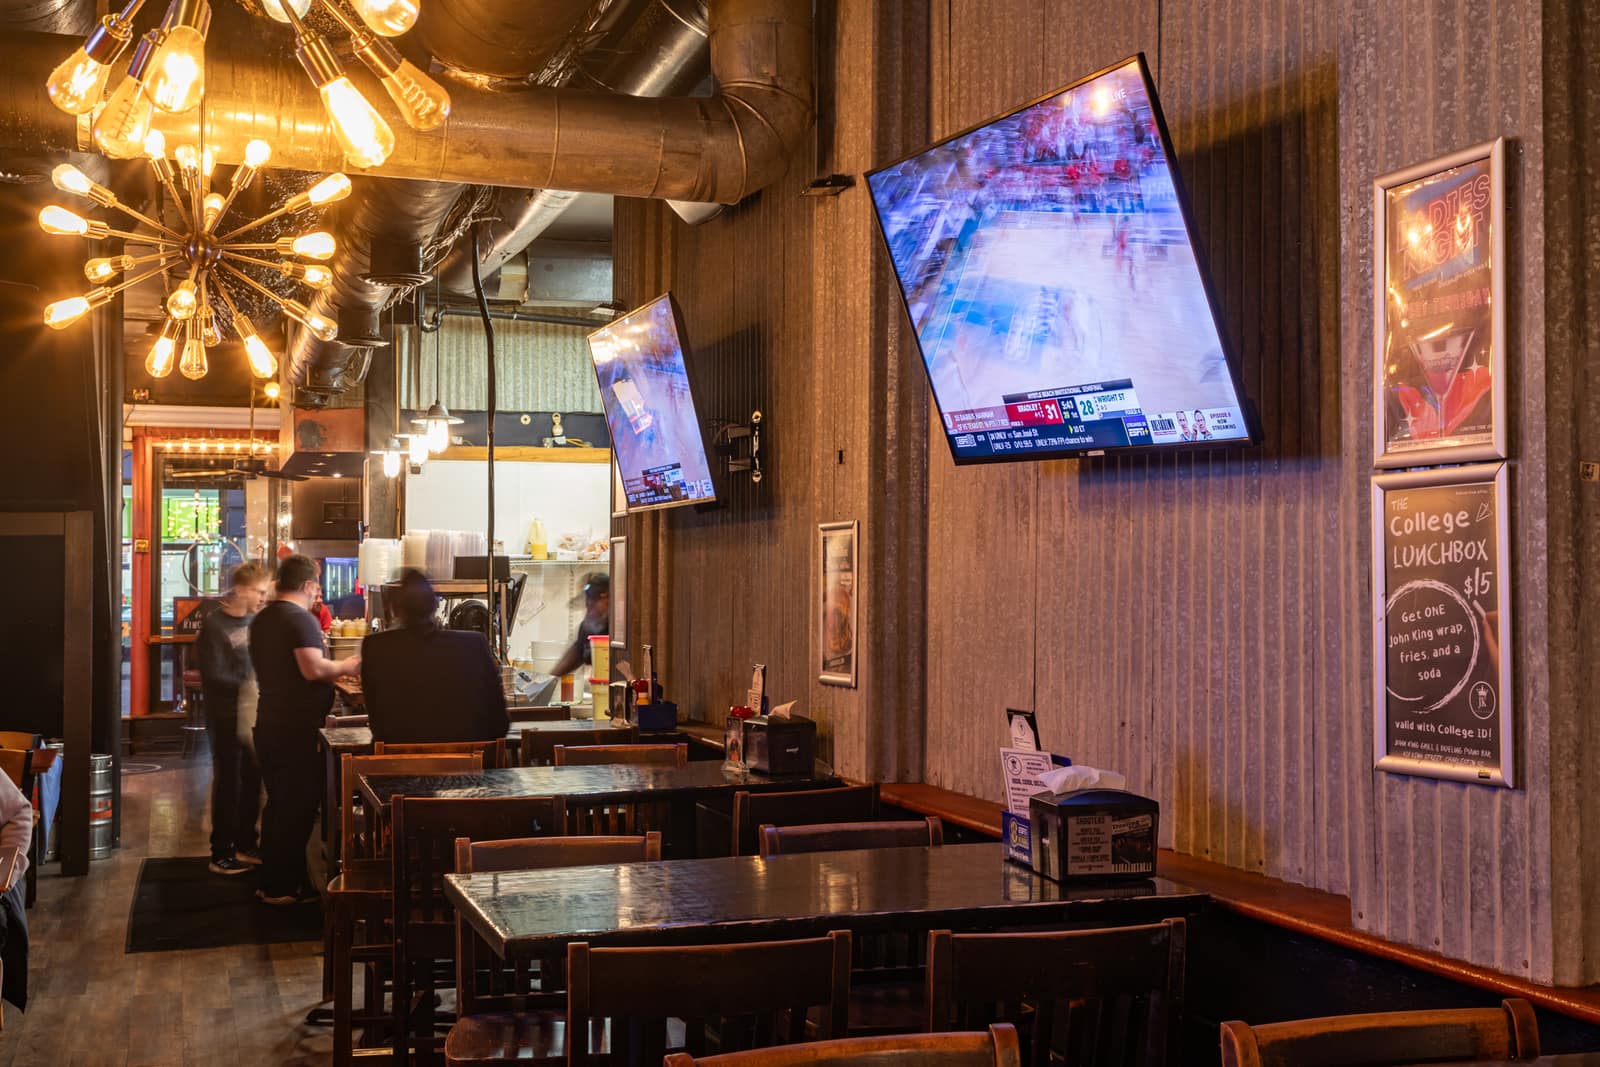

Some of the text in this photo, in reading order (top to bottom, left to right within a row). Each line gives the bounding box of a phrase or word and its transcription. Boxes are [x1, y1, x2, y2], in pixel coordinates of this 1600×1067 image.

[1097, 393, 1126, 403] WRIGHT ST
[1017, 403, 1038, 412] BRADLEY
[1045, 404, 1059, 420] 31
[1080, 400, 1095, 416] 28
[1128, 426, 1149, 437] ESPN+
[1212, 423, 1236, 431] STREAMING
[1014, 431, 1022, 439] San
[1391, 497, 1408, 511] THE
[1390, 510, 1470, 537] College
[1393, 538, 1488, 568] LUNCHBOX
[1464, 567, 1493, 599] $15
[1401, 604, 1446, 623] Get ONE
[1389, 632, 1410, 648] John
[1412, 628, 1434, 641] King
[1432, 644, 1451, 657] and
[1454, 645, 1460, 654] a
[1418, 668, 1441, 681] soda
[1395, 720, 1492, 742] valid with College ID!
[1408, 741, 1419, 749] KING
